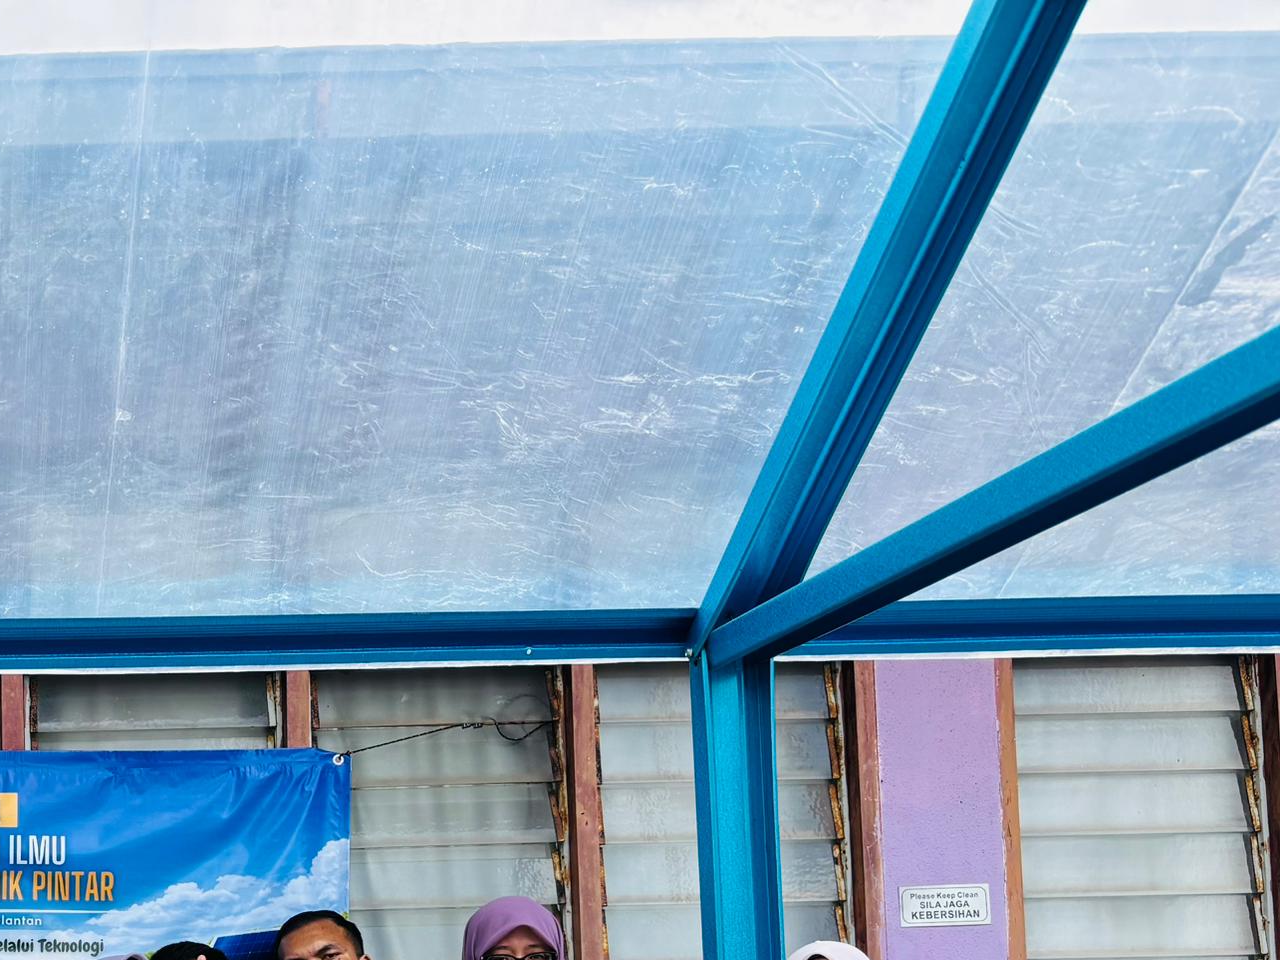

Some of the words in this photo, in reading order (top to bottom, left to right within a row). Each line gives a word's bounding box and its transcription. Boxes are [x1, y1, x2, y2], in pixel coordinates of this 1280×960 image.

[8, 834, 66, 865] ILMU
[32, 870, 115, 901] PINTAR
[920, 901, 942, 909] SILA
[943, 900, 970, 908] JAGA
[911, 909, 980, 920] KEBERSIHAN
[37, 938, 104, 957] Teknologi
